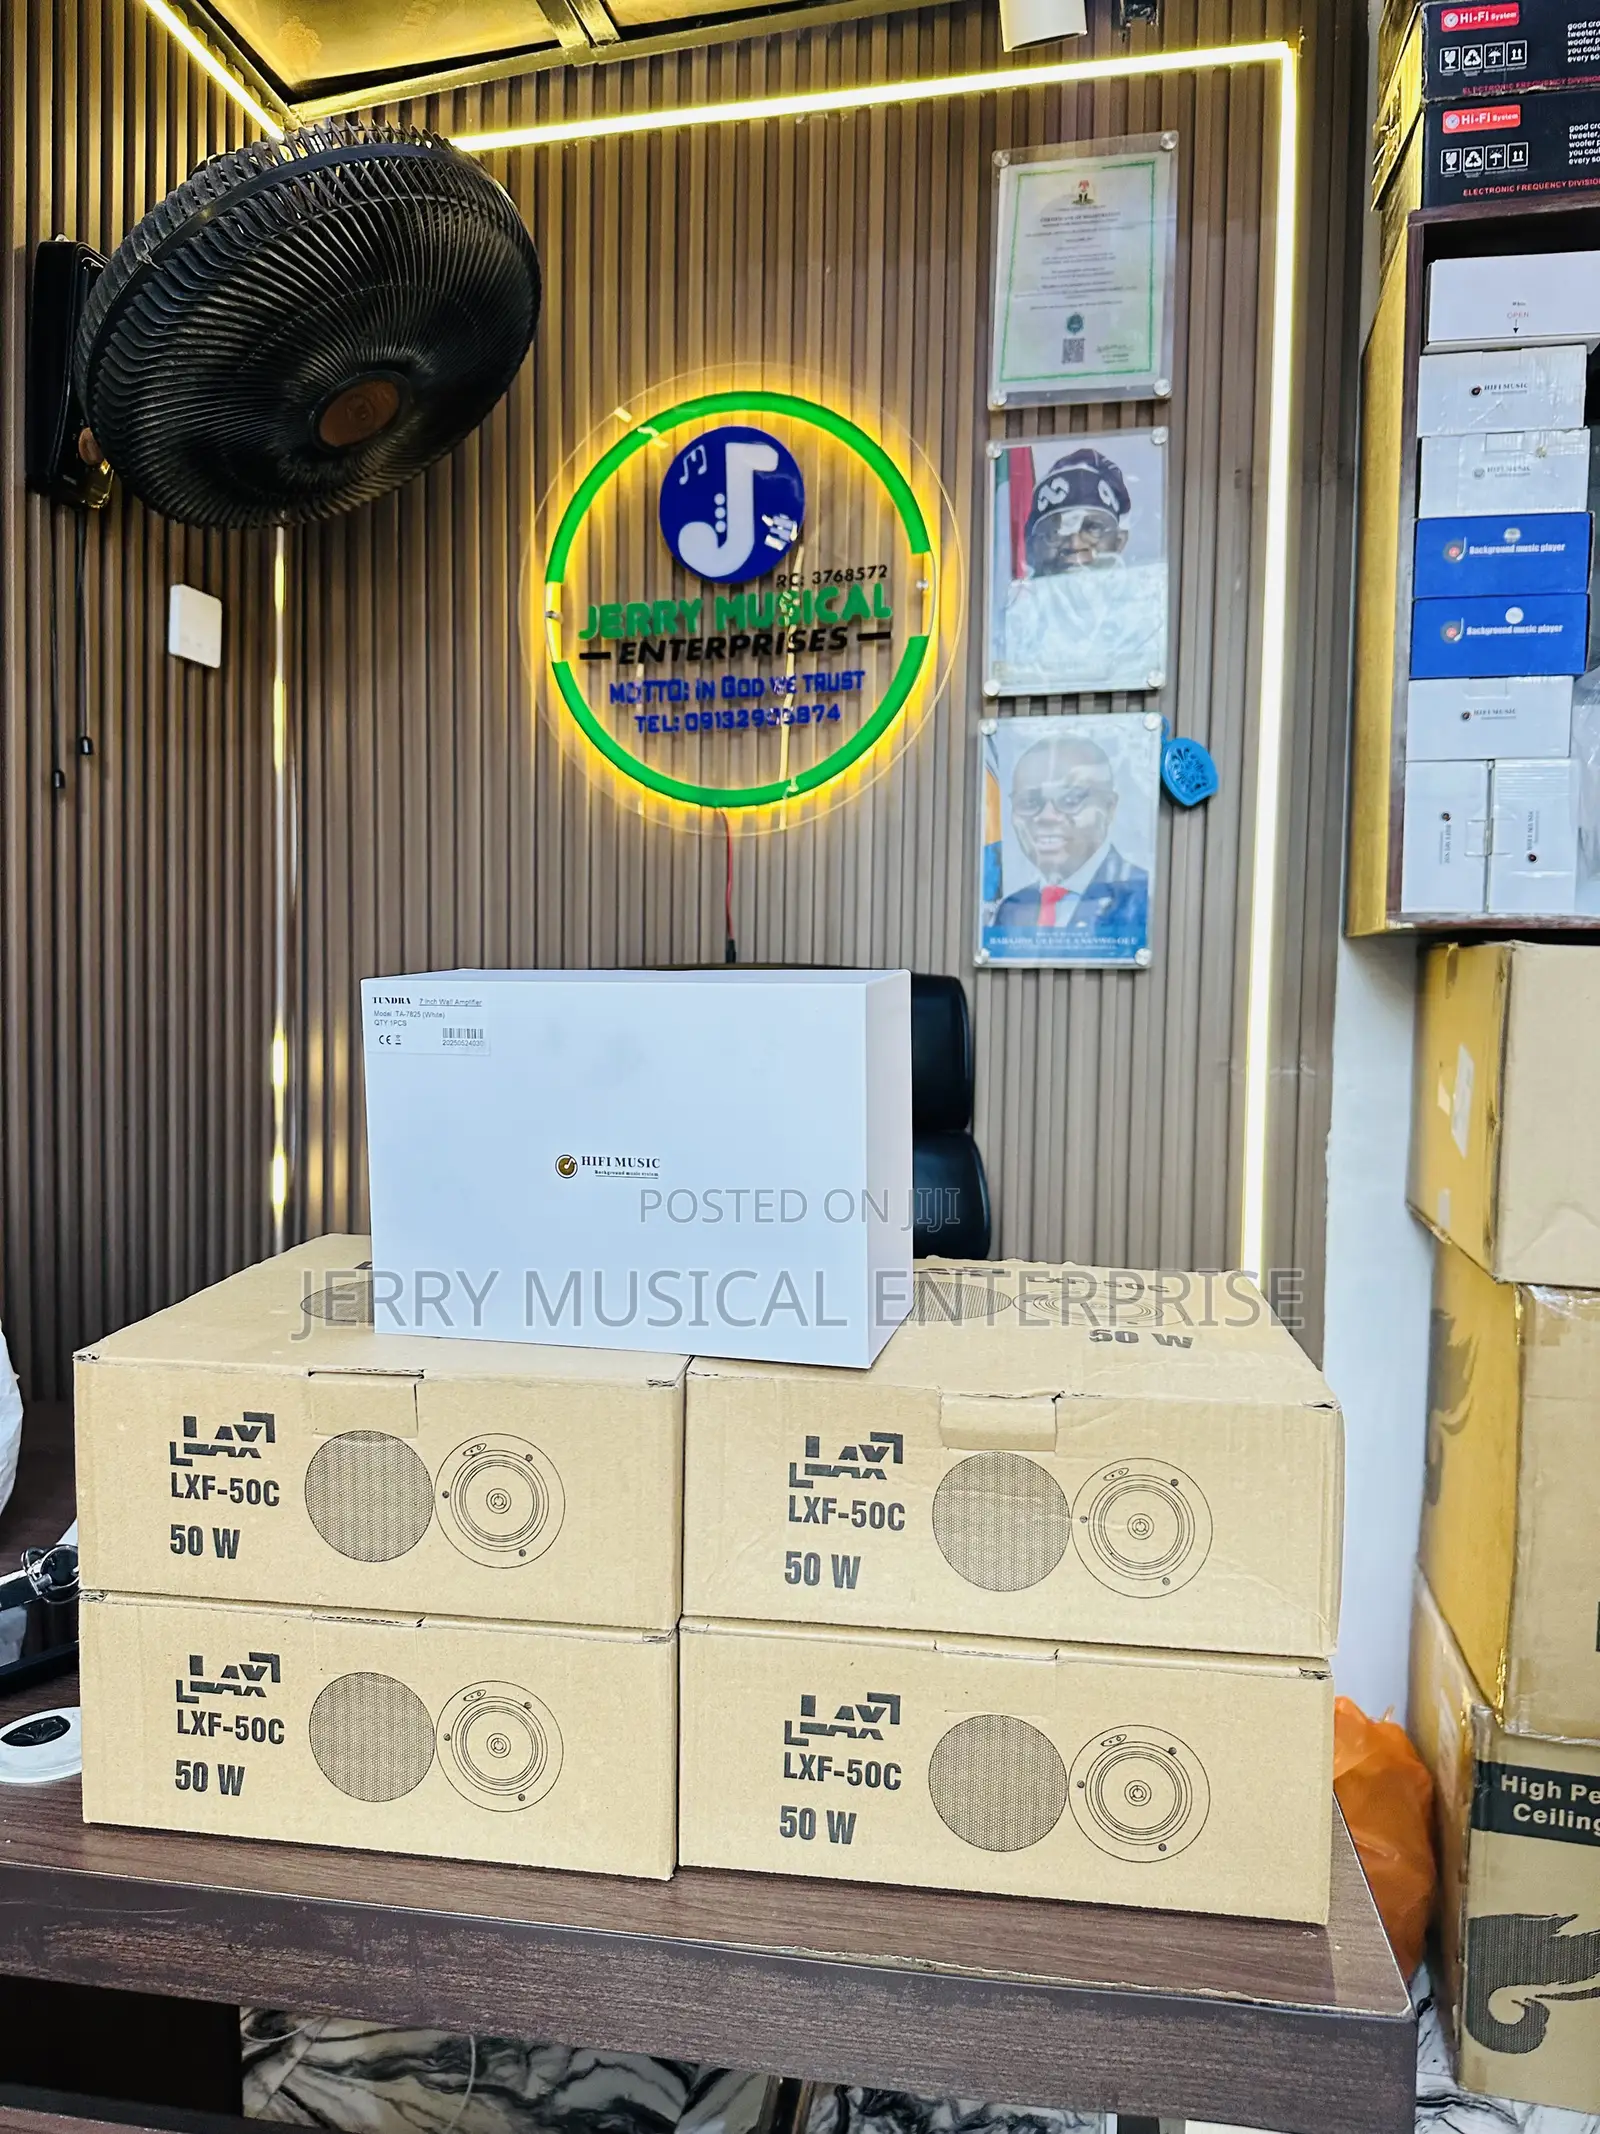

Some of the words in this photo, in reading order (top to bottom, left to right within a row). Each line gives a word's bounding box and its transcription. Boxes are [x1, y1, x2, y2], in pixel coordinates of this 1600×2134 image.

[1567, 21, 1587, 31] good
[1567, 29, 1600, 38] tweeter,
[1567, 37, 1594, 46] woofer
[1567, 47, 1582, 55] you
[1567, 55, 1589, 63] every
[1568, 122, 1589, 133] good
[1568, 139, 1595, 148] woofer
[1568, 149, 1583, 158] you
[1568, 157, 1590, 165] every
[1463, 185, 1514, 197] ELECTRONIC
[1516, 180, 1567, 192] FREQUENCY
[1568, 177, 1600, 188] DIVISIO
[1469, 544, 1515, 556] Background
[1516, 543, 1540, 553] music
[1540, 542, 1565, 552] player
[812, 564, 888, 584] 3768572
[578, 596, 703, 640] JERRY
[715, 583, 893, 632] MUSICAL
[1466, 625, 1513, 636] Background
[1513, 624, 1537, 634] music
[1537, 623, 1563, 634] player
[618, 626, 850, 665] ENTERPRISES
[609, 679, 690, 704] MOTTO:
[802, 670, 866, 693] TRUST
[634, 713, 680, 733] TEL:
[372, 997, 411, 1005] TUNDRA
[454, 998, 483, 1007] Amplifier
[581, 1156, 611, 1166] HIFI
[614, 1157, 661, 1168] MUSIC
[1088, 1329, 1139, 1343] 50
[1151, 1333, 1193, 1349] W
[171, 1472, 280, 1506] LXF-50C
[789, 1495, 905, 1531] LXF-50C
[170, 1524, 204, 1556] 50
[212, 1527, 241, 1559] W
[785, 1551, 821, 1586] 50
[831, 1554, 861, 1589] W
[177, 1709, 285, 1744] LXF-50C
[175, 1760, 209, 1792] 50
[217, 1764, 245, 1796] W
[784, 1751, 901, 1790] LXF-50C
[1501, 1774, 1561, 1801] High
[780, 1805, 816, 1840] 50
[826, 1810, 857, 1844] W
